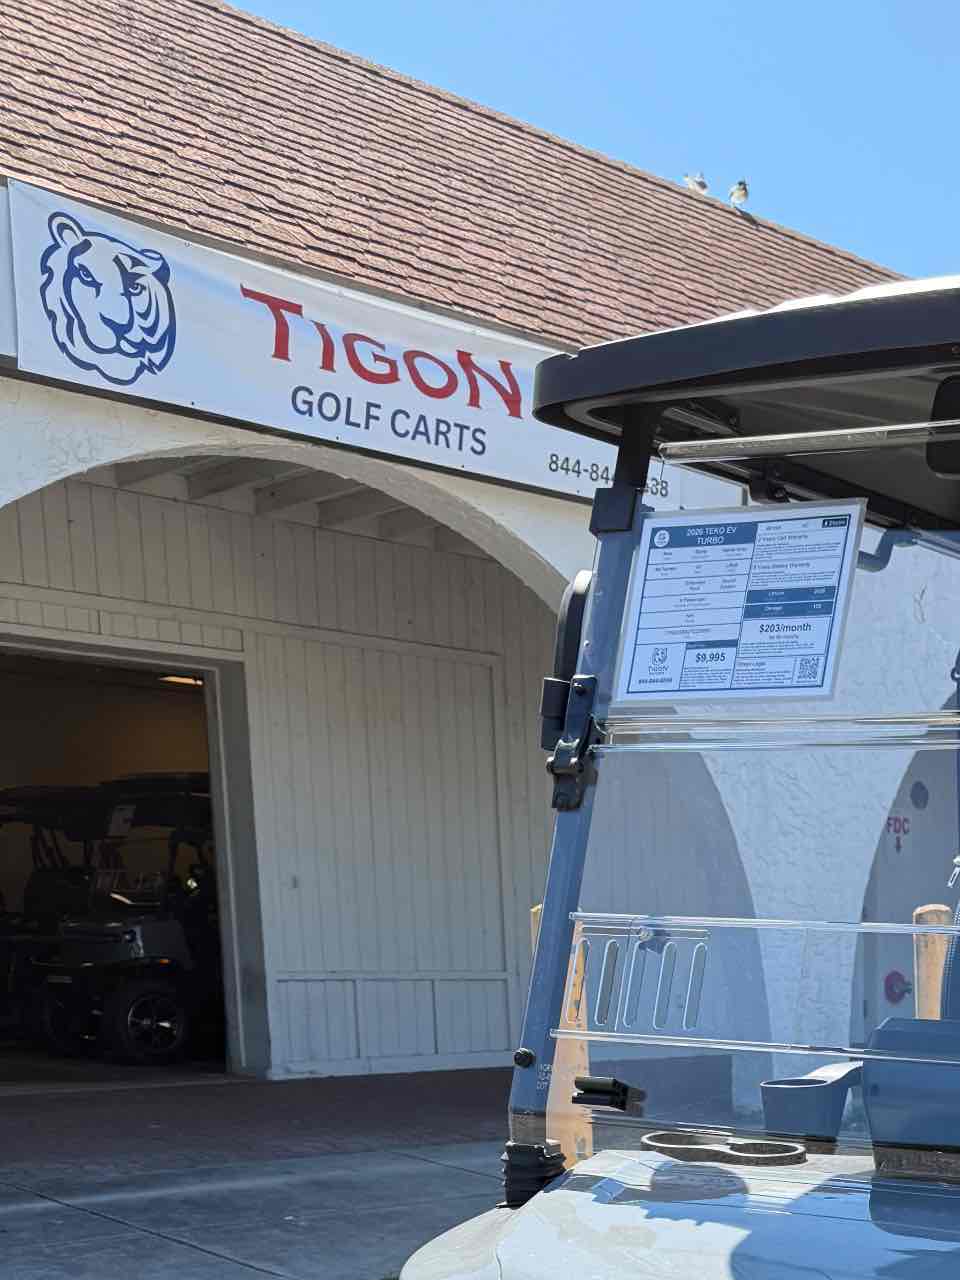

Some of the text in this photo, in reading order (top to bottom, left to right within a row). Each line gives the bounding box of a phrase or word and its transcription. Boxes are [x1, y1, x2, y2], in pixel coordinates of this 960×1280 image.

[239, 283, 523, 420] TIGON
[291, 386, 487, 456] GOLF CARTS
[696, 536, 725, 545] TURBO
[759, 623, 812, 633] $203/month
[695, 652, 726, 664] $9,995
[886, 816, 911, 834] FDC
